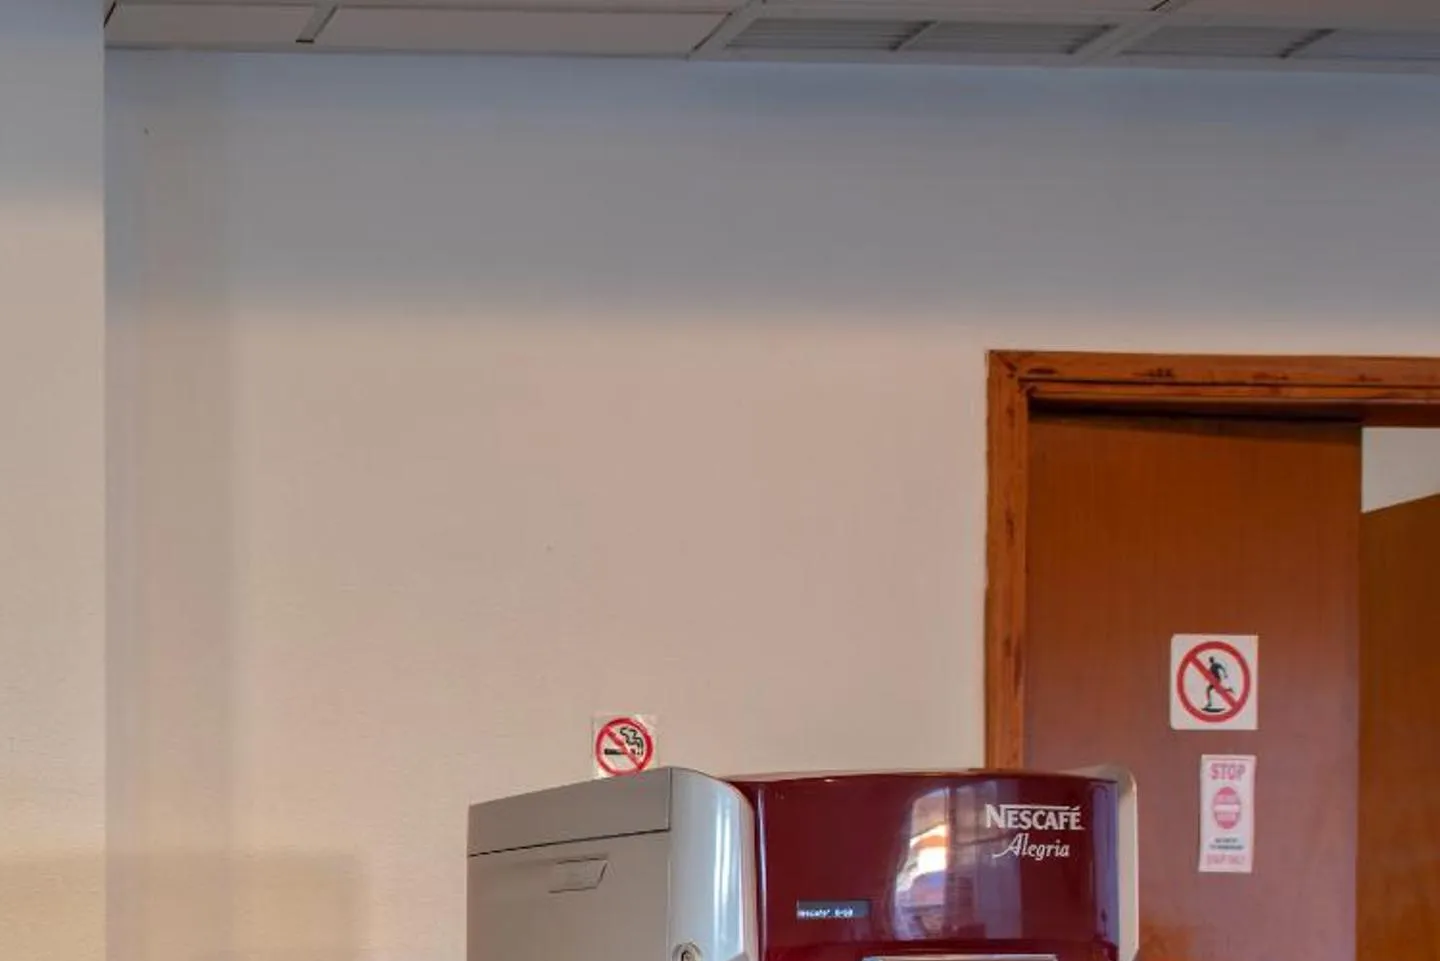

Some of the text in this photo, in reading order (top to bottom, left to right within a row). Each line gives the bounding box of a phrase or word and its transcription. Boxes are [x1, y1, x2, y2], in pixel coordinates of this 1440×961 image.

[1209, 763, 1246, 781] STOP
[985, 803, 1086, 830] NESCAFÉ
[992, 832, 1071, 861] Alegria
